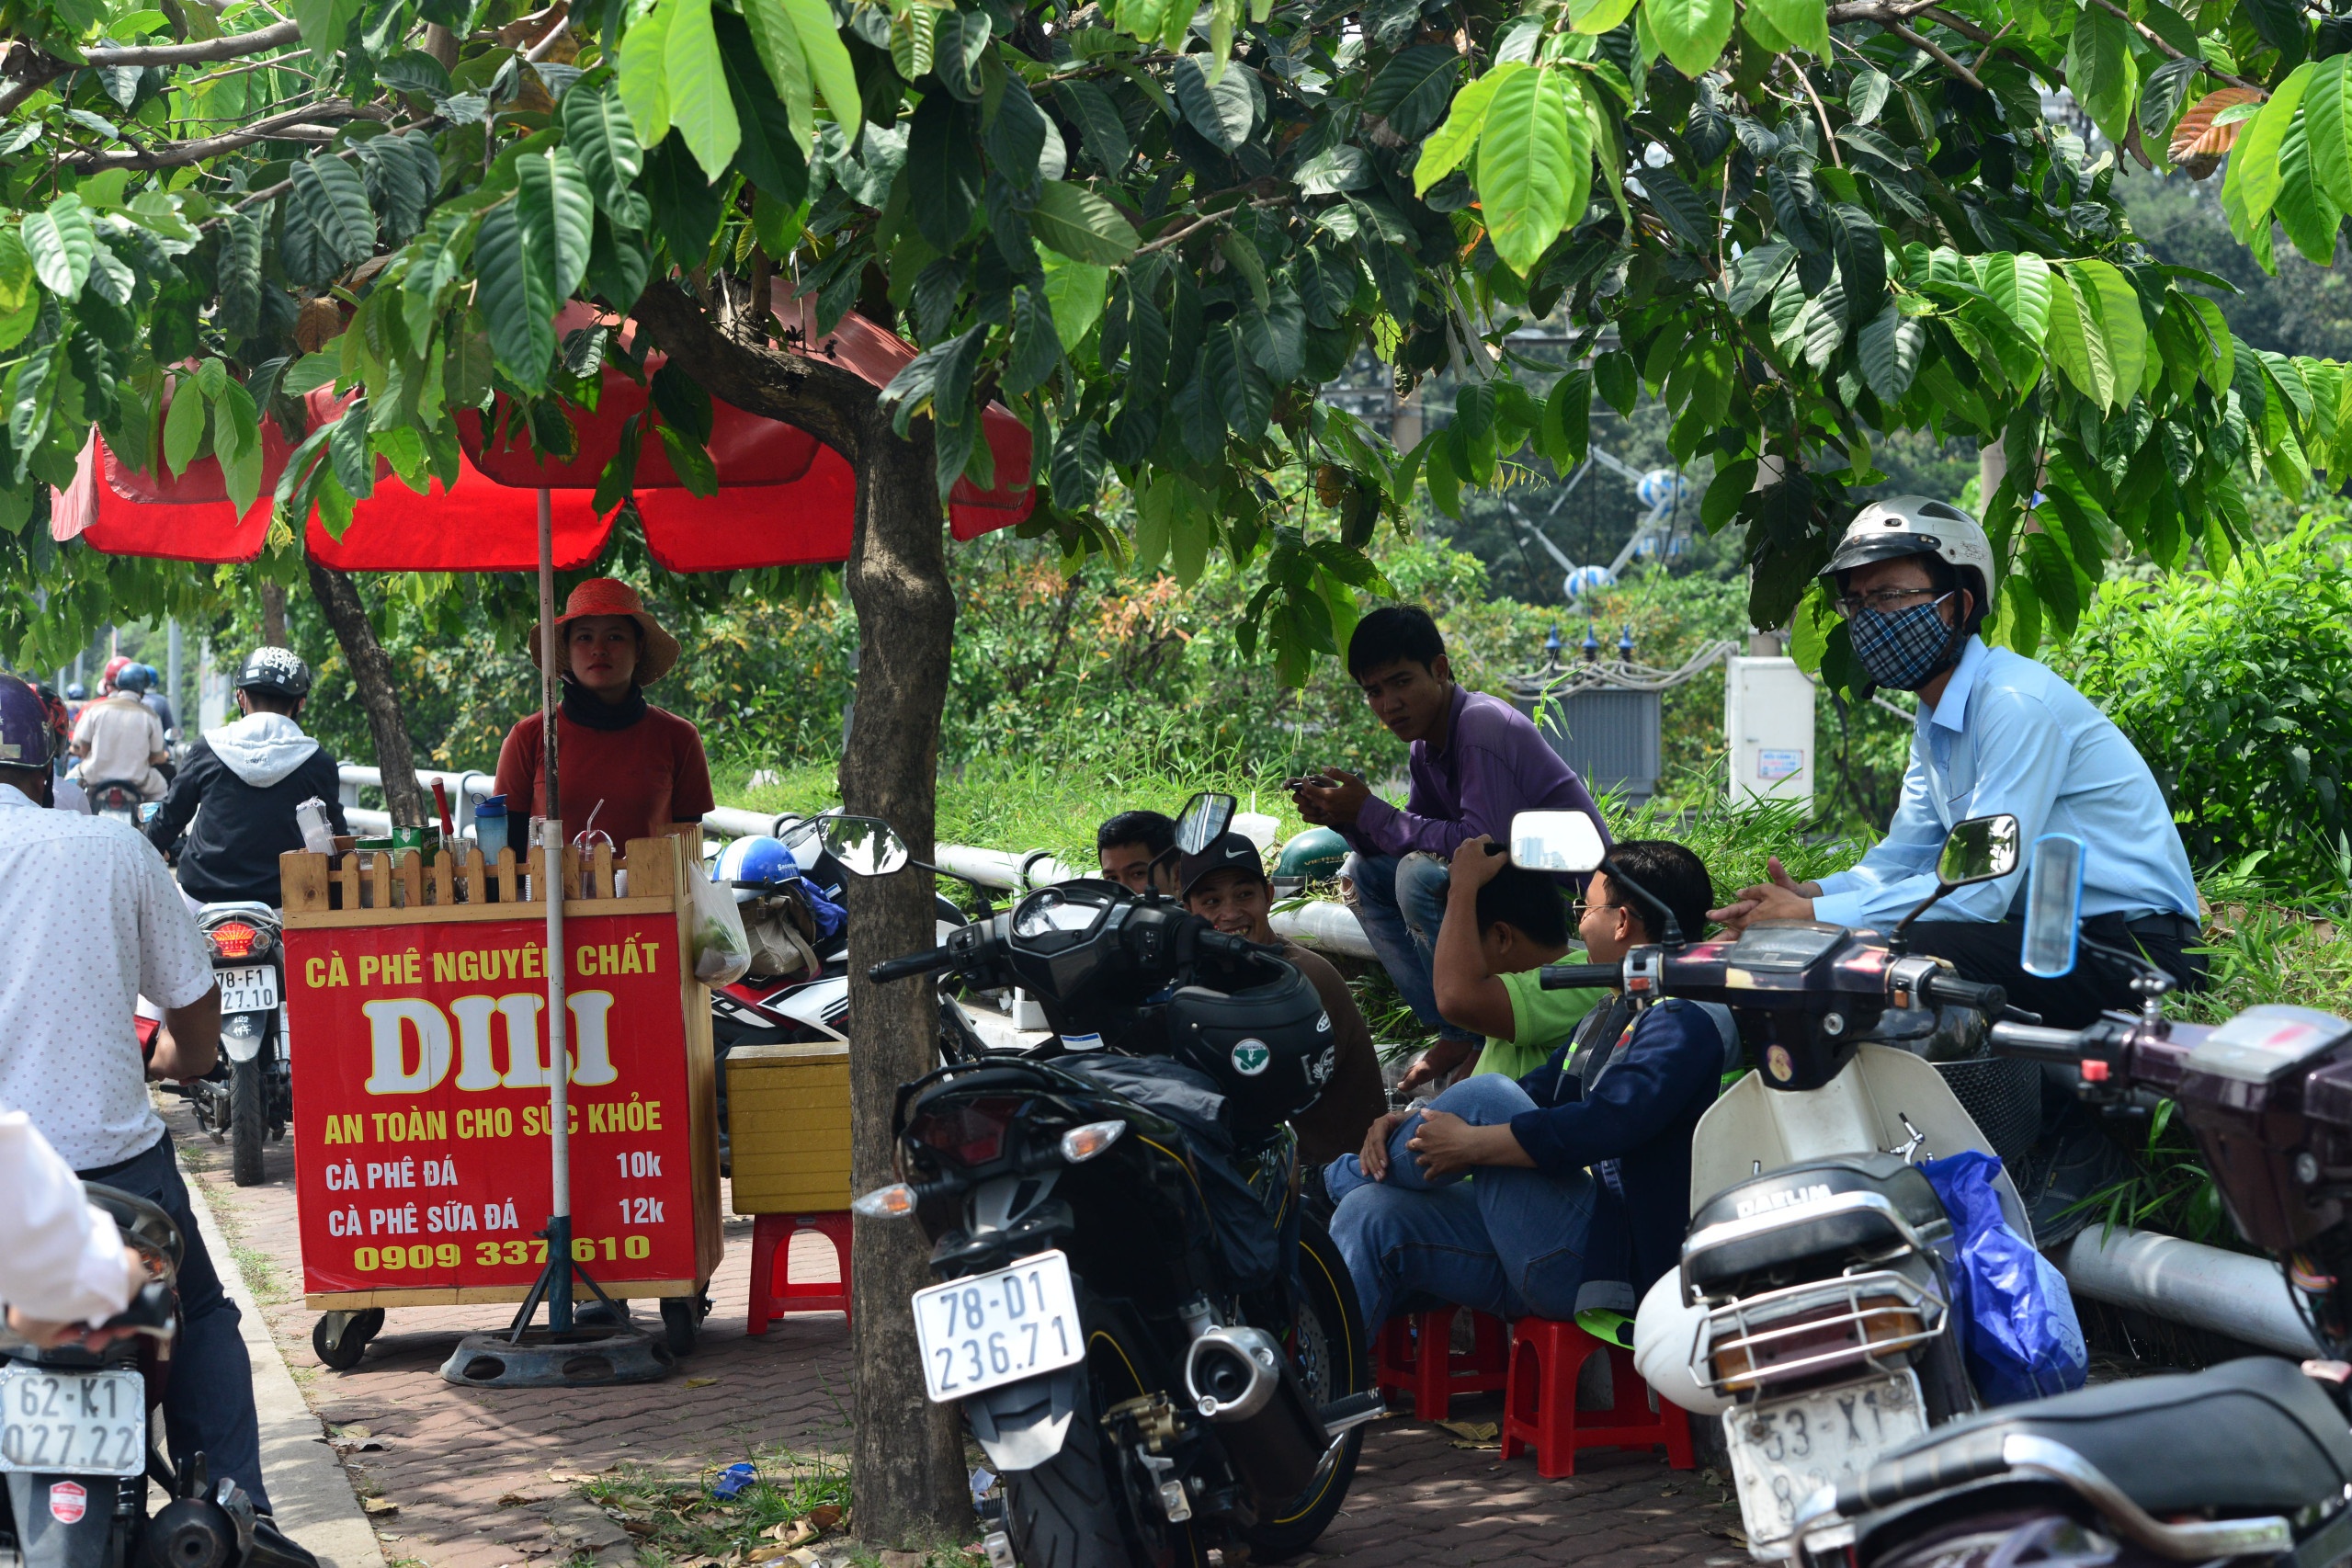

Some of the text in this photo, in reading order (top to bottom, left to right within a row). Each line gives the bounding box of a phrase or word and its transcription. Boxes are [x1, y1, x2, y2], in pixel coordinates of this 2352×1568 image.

[215, 969, 264, 990] 78-F1
[306, 950, 349, 988] CÀ
[359, 947, 422, 985] PHÊ
[577, 932, 660, 975] CHẤT
[222, 988, 273, 1011] 27.10
[362, 990, 619, 1095] DILI
[324, 1113, 363, 1144] AN
[372, 1106, 447, 1142] TOÀN
[456, 1108, 513, 1138] CHO
[588, 1092, 662, 1132] KHỎE
[325, 1152, 662, 1190] CÀ PHÊ ĐÁ 10k
[328, 1197, 665, 1237] CÀ PHÊ SỮA ĐÁ 12k
[1736, 1183, 1833, 1220] DAELIM
[354, 1235, 650, 1271] 0909 337 610
[939, 1270, 1045, 1338] 78-D1
[935, 1314, 1069, 1392] 236.71
[20, 1377, 117, 1419] 62-K1
[3, 1423, 136, 1467] 027.22
